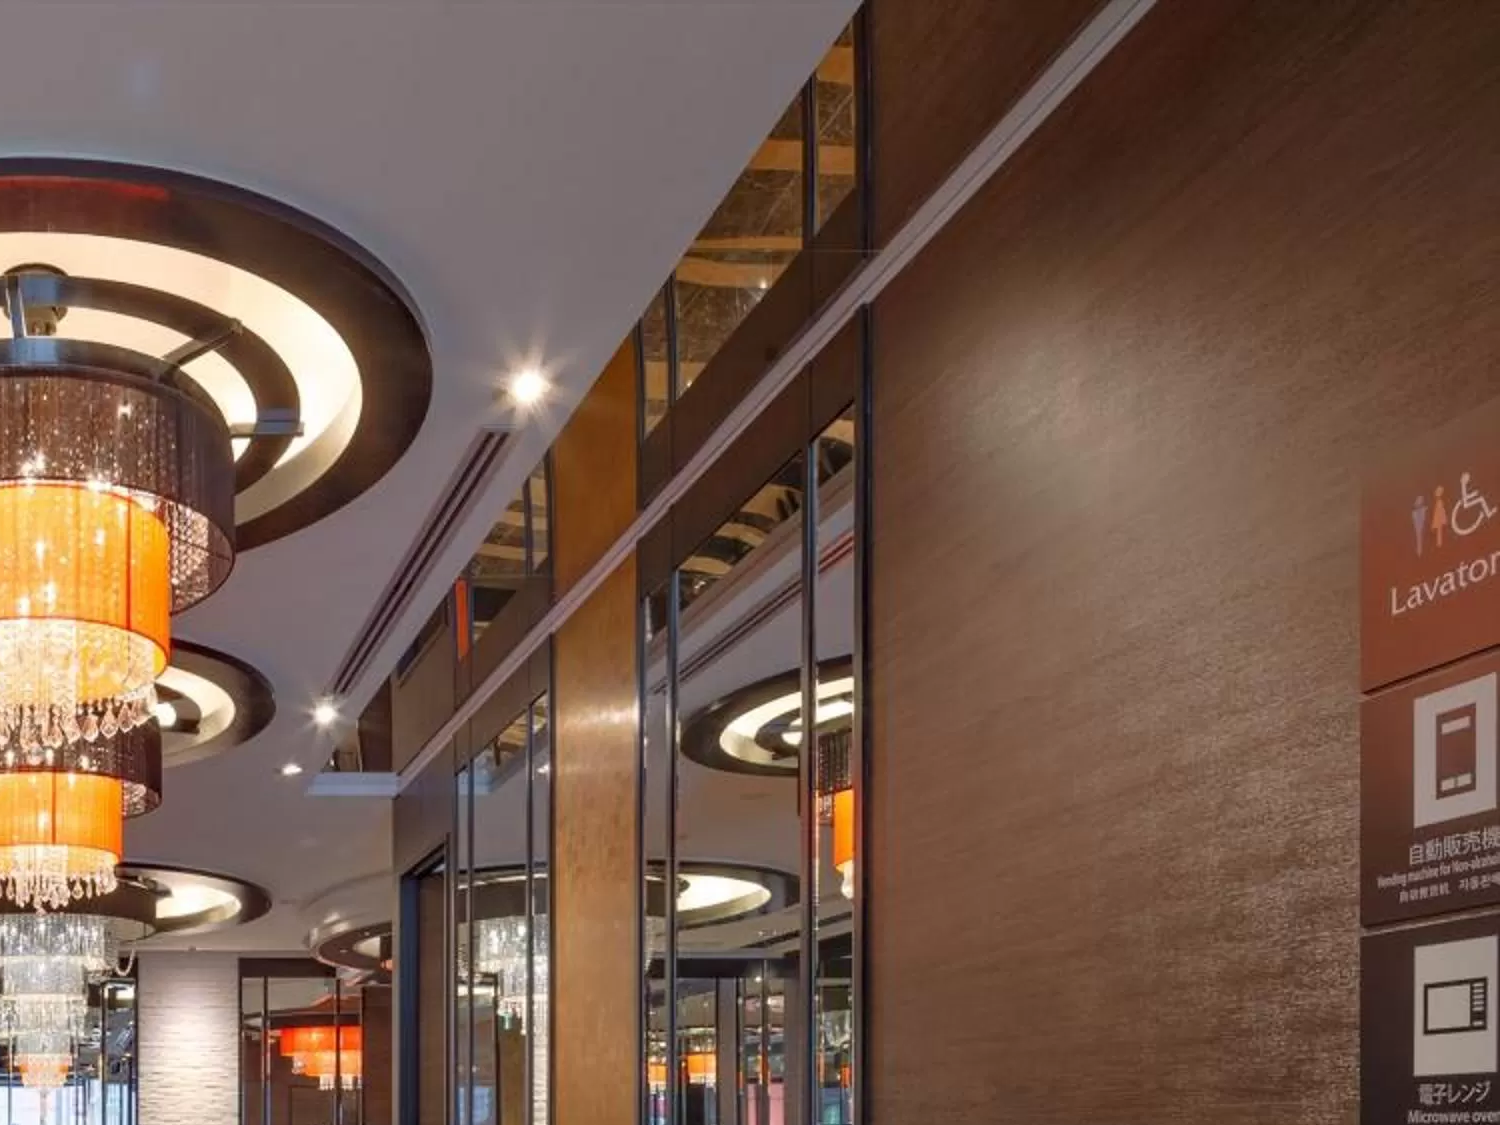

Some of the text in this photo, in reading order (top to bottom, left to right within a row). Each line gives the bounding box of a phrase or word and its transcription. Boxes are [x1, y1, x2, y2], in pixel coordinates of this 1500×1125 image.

[1418, 1081, 1491, 1105] 電子レンジ
